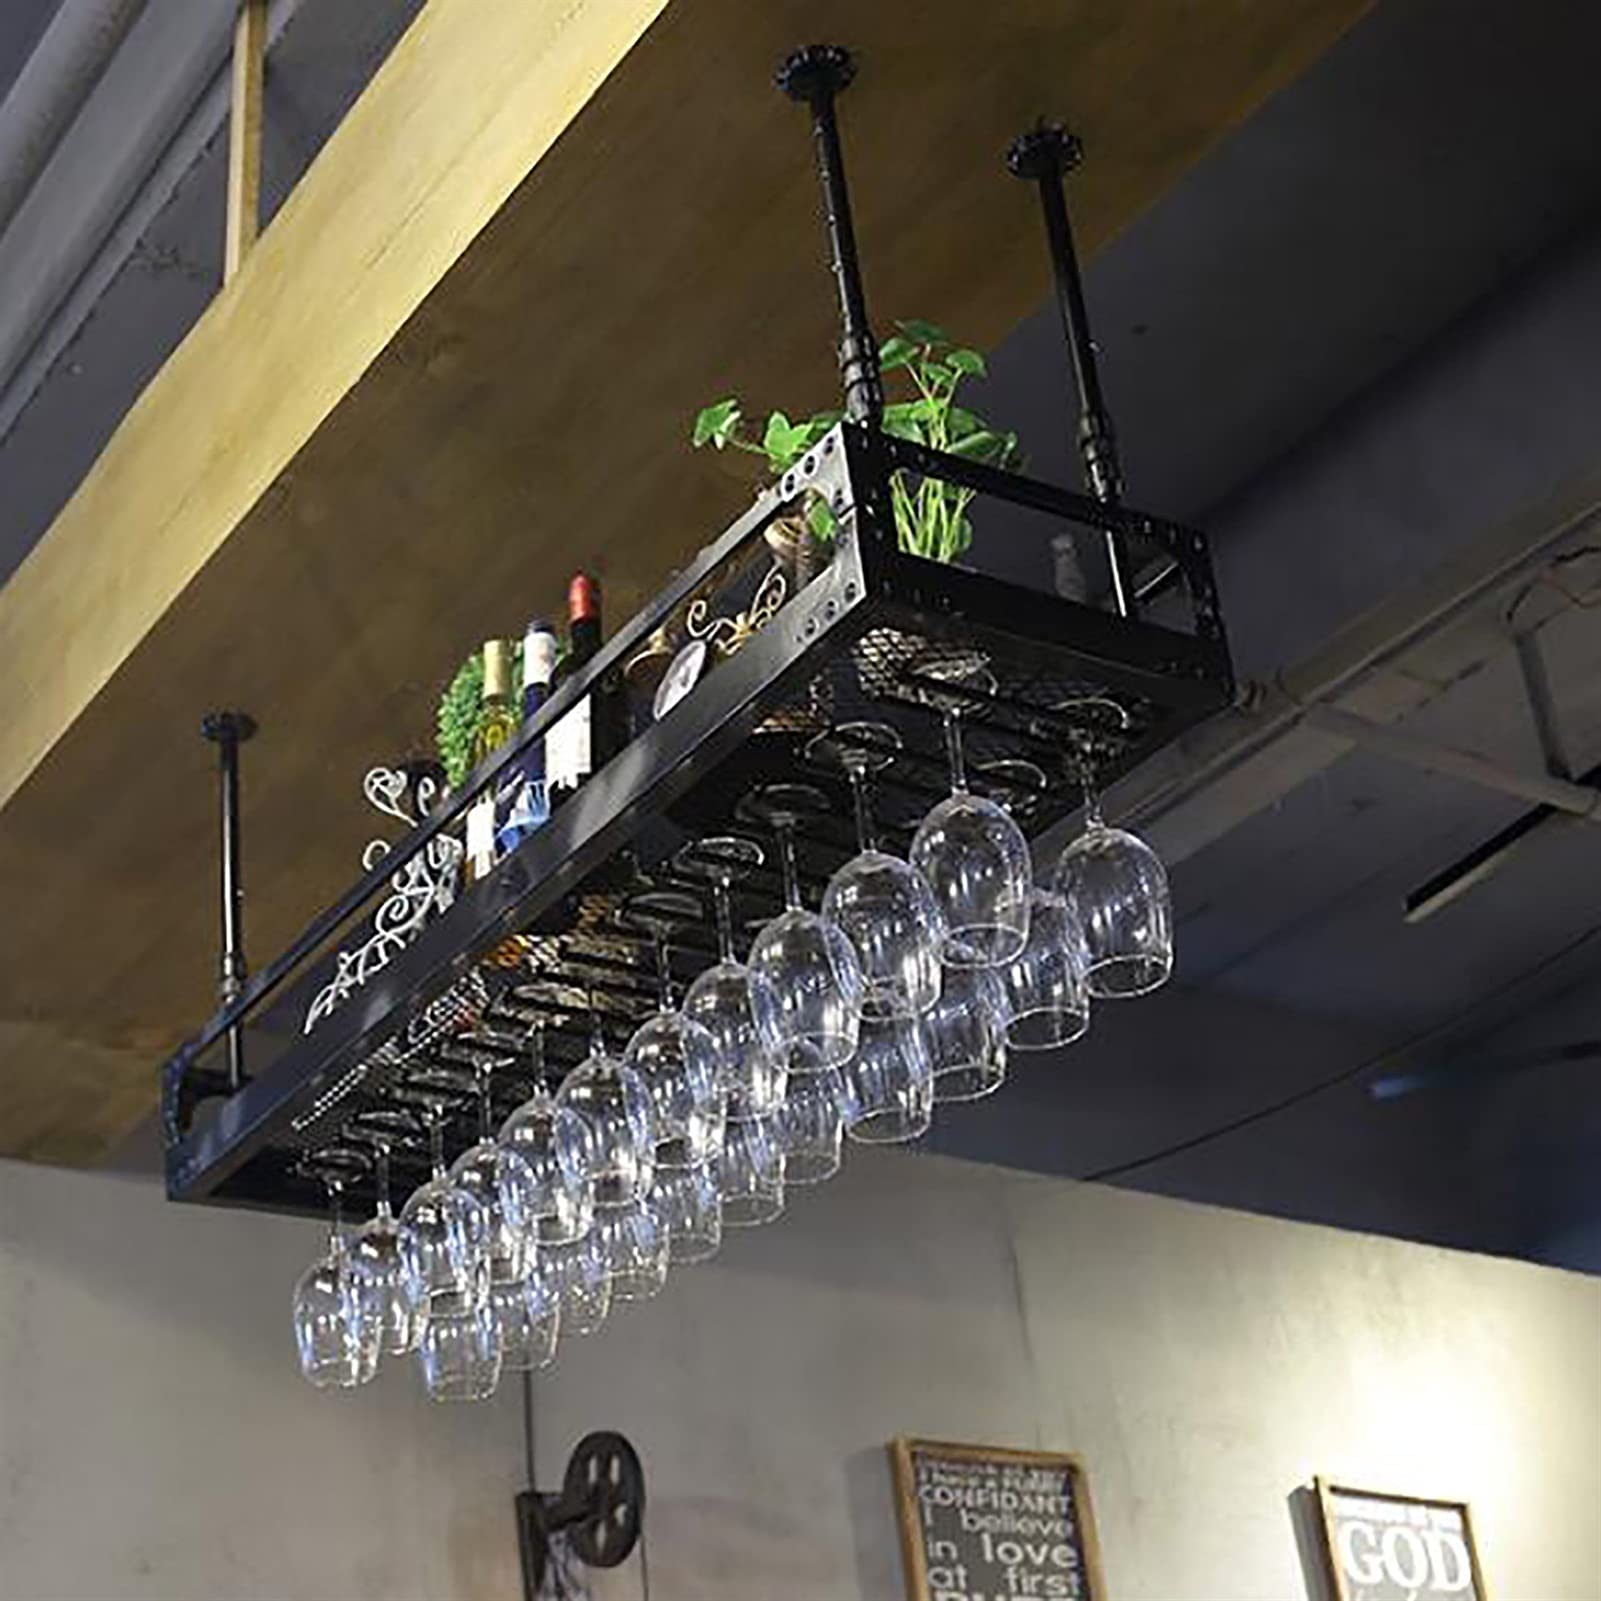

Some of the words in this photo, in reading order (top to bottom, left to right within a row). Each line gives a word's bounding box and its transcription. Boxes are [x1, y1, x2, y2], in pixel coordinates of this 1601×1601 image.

[927, 1534, 958, 1560] in
[981, 1532, 1077, 1567] love
[1338, 1521, 1471, 1591] GOD
[928, 1563, 967, 1589] at
[1004, 1566, 1080, 1594] first
